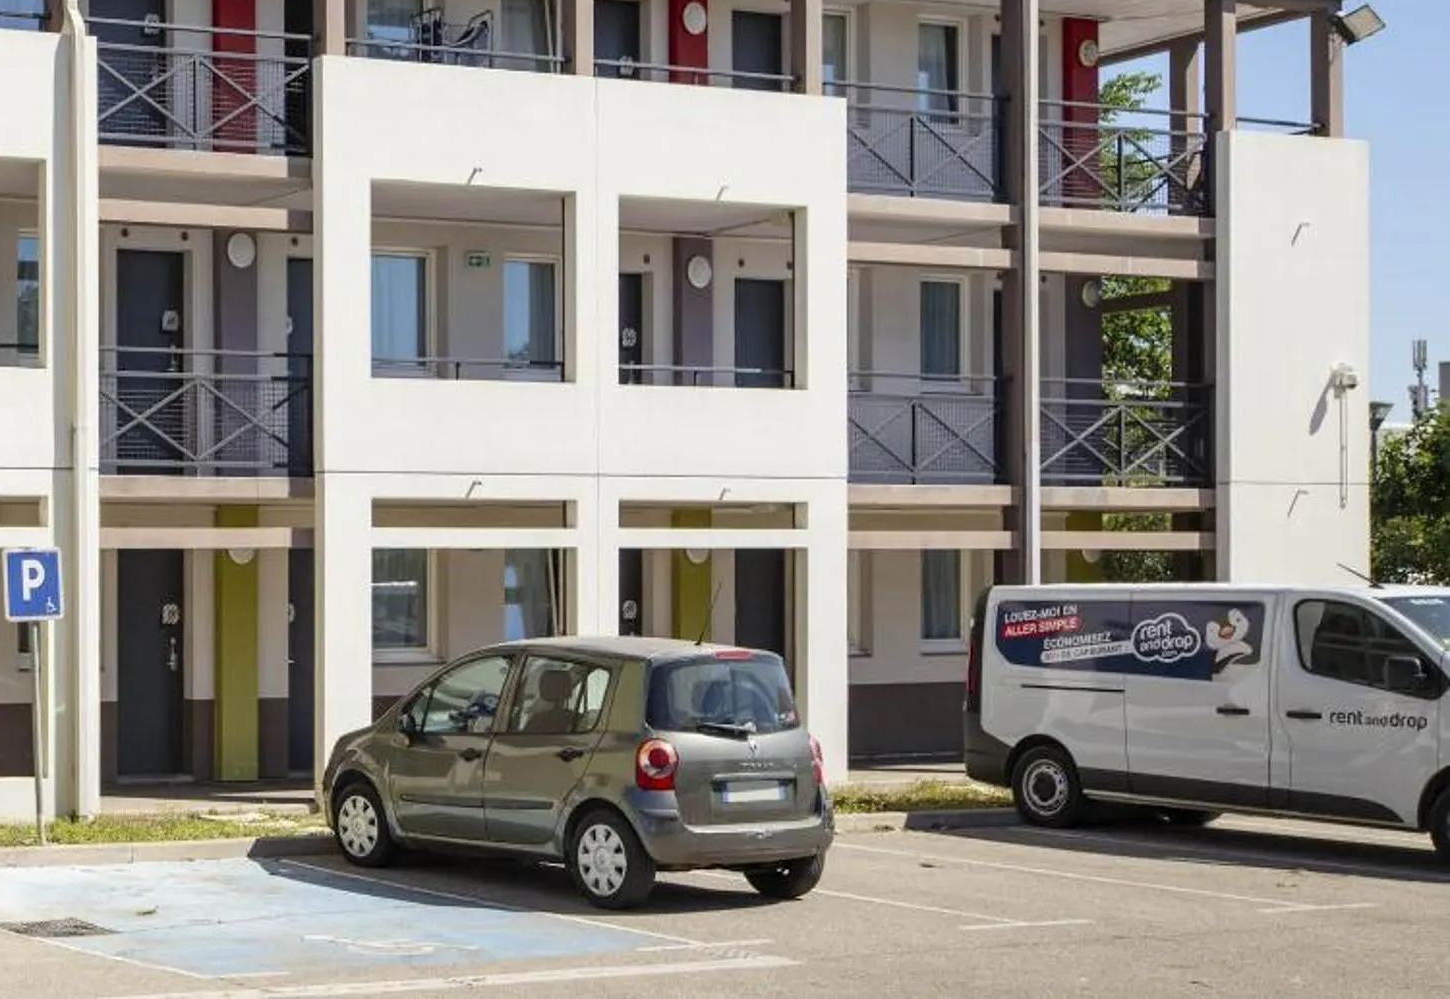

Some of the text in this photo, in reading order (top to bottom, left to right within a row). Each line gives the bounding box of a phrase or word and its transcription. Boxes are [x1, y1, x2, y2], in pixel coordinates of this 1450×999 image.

[22, 559, 45, 601] P
[1063, 604, 1078, 616] EN
[1004, 616, 1077, 637] ALLER SIMPLE
[1140, 620, 1172, 640] rent
